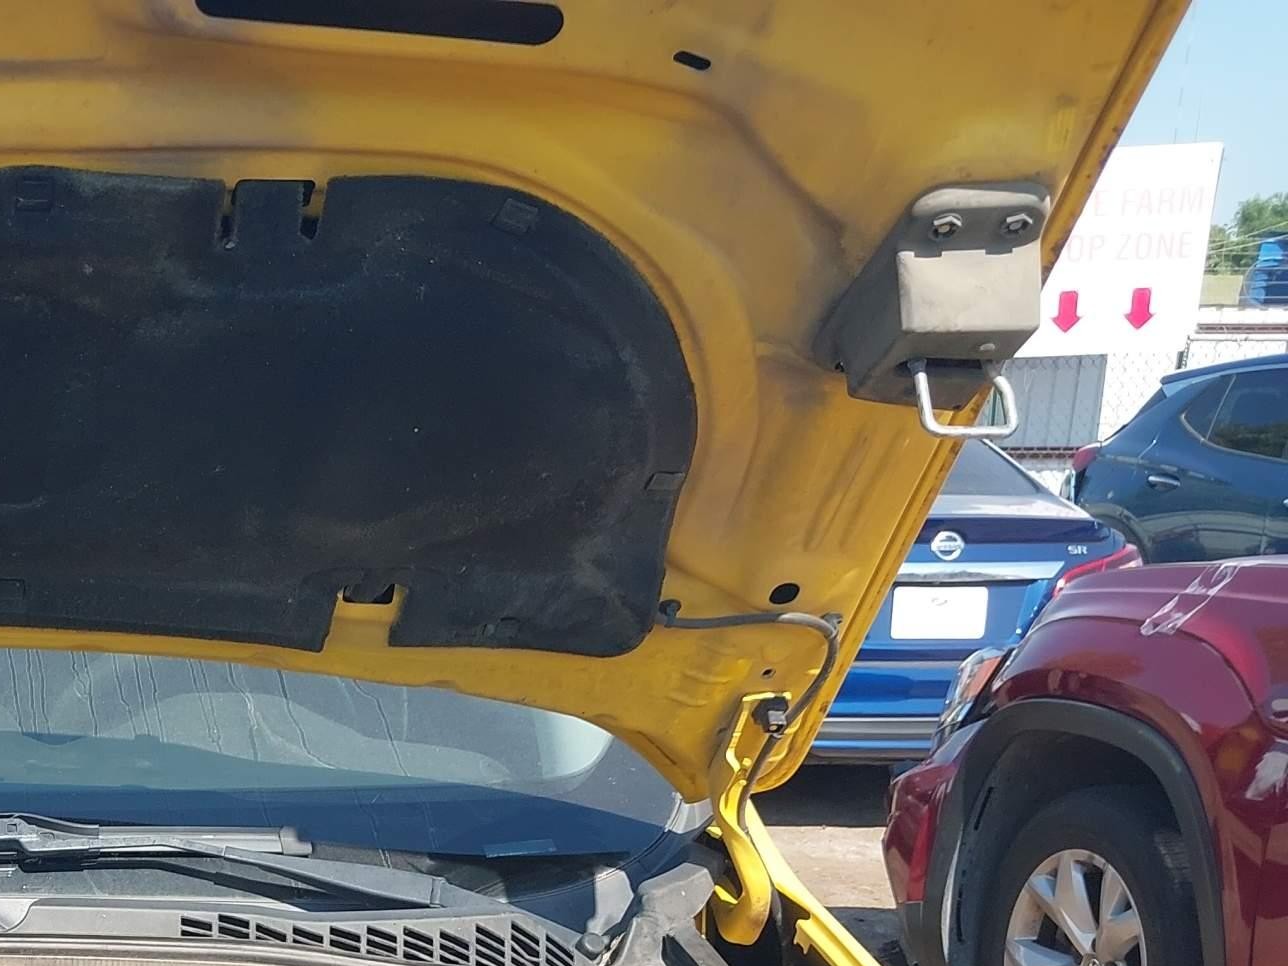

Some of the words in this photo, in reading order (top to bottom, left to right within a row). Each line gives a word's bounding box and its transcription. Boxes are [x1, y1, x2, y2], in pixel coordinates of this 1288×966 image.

[1121, 185, 1205, 217] FARM
[1115, 232, 1192, 261] ZONE
[1067, 545, 1087, 555] SR
